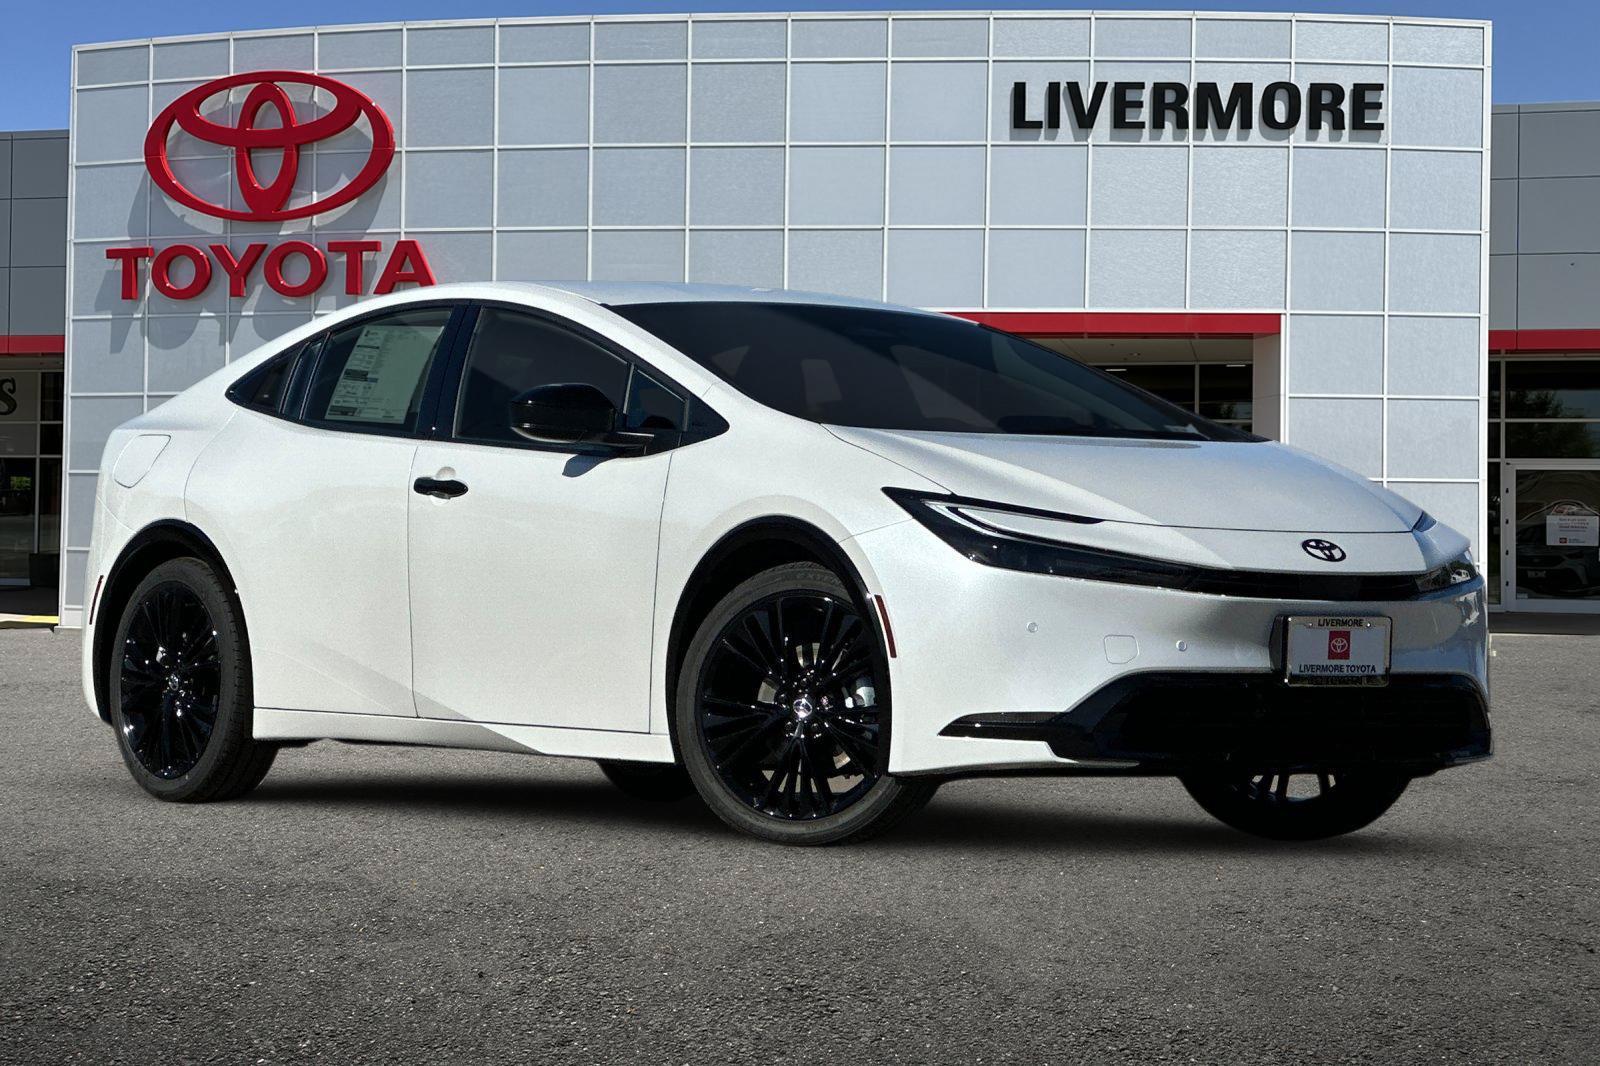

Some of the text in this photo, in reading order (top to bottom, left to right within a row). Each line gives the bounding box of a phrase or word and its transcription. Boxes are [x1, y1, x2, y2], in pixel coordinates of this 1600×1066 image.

[1012, 81, 1385, 131] LIVERMORE
[106, 240, 437, 300] TOYOTA
[1317, 618, 1364, 627] LIVERMORE
[1298, 664, 1376, 673] LIVERMORE TOYOTA
